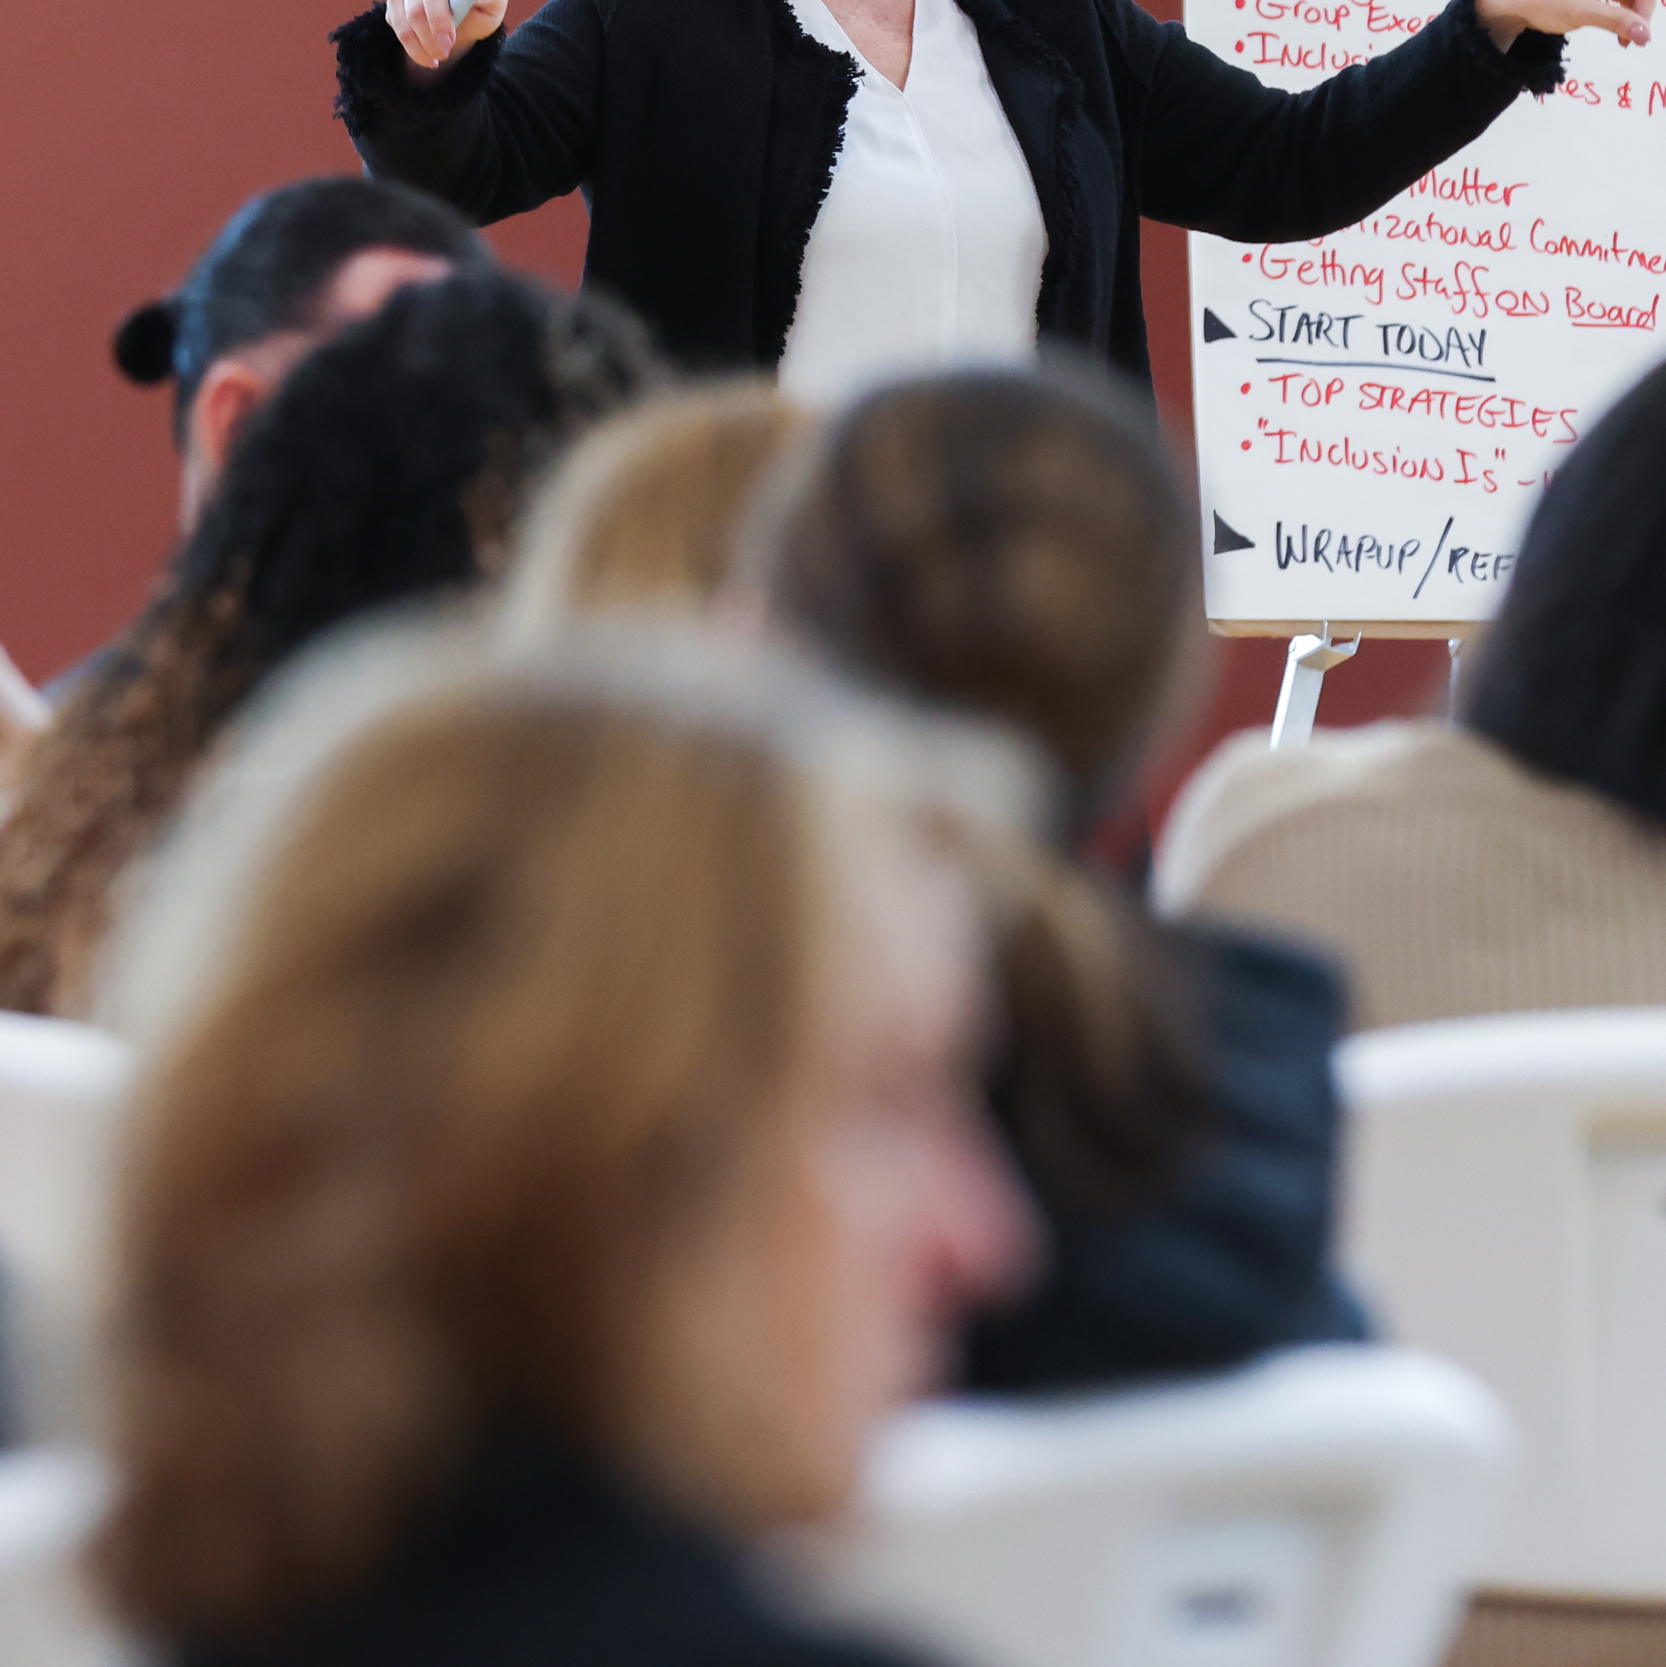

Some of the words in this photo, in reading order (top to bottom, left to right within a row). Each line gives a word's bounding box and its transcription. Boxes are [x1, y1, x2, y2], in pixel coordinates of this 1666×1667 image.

[1396, 259, 1490, 319] Staff
[1566, 286, 1660, 327] Board
[1248, 298, 1365, 348] START
[1376, 323, 1487, 368] TODAY
[1268, 373, 1345, 407] TOP
[1359, 381, 1579, 445] STRATEGIES
